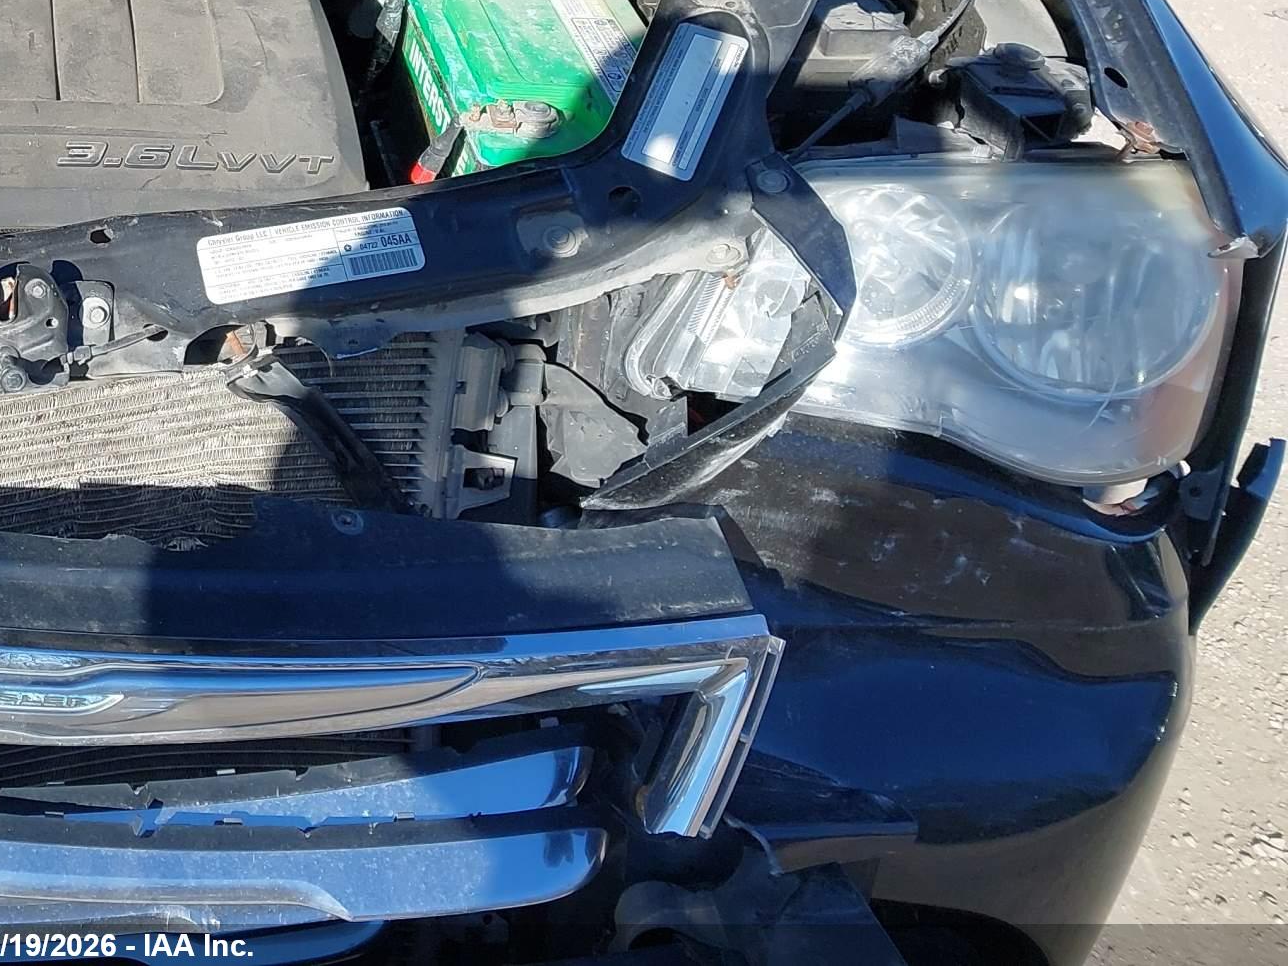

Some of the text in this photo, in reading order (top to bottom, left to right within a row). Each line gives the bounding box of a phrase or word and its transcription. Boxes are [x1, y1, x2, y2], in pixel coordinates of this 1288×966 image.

[56, 140, 335, 174] 3.6L VVT
[275, 224, 299, 234] VEHICLE
[301, 220, 330, 230] EMISSION
[332, 216, 360, 226] CONTROL
[361, 209, 403, 222] INFORMATION
[380, 233, 412, 247] 045AA
